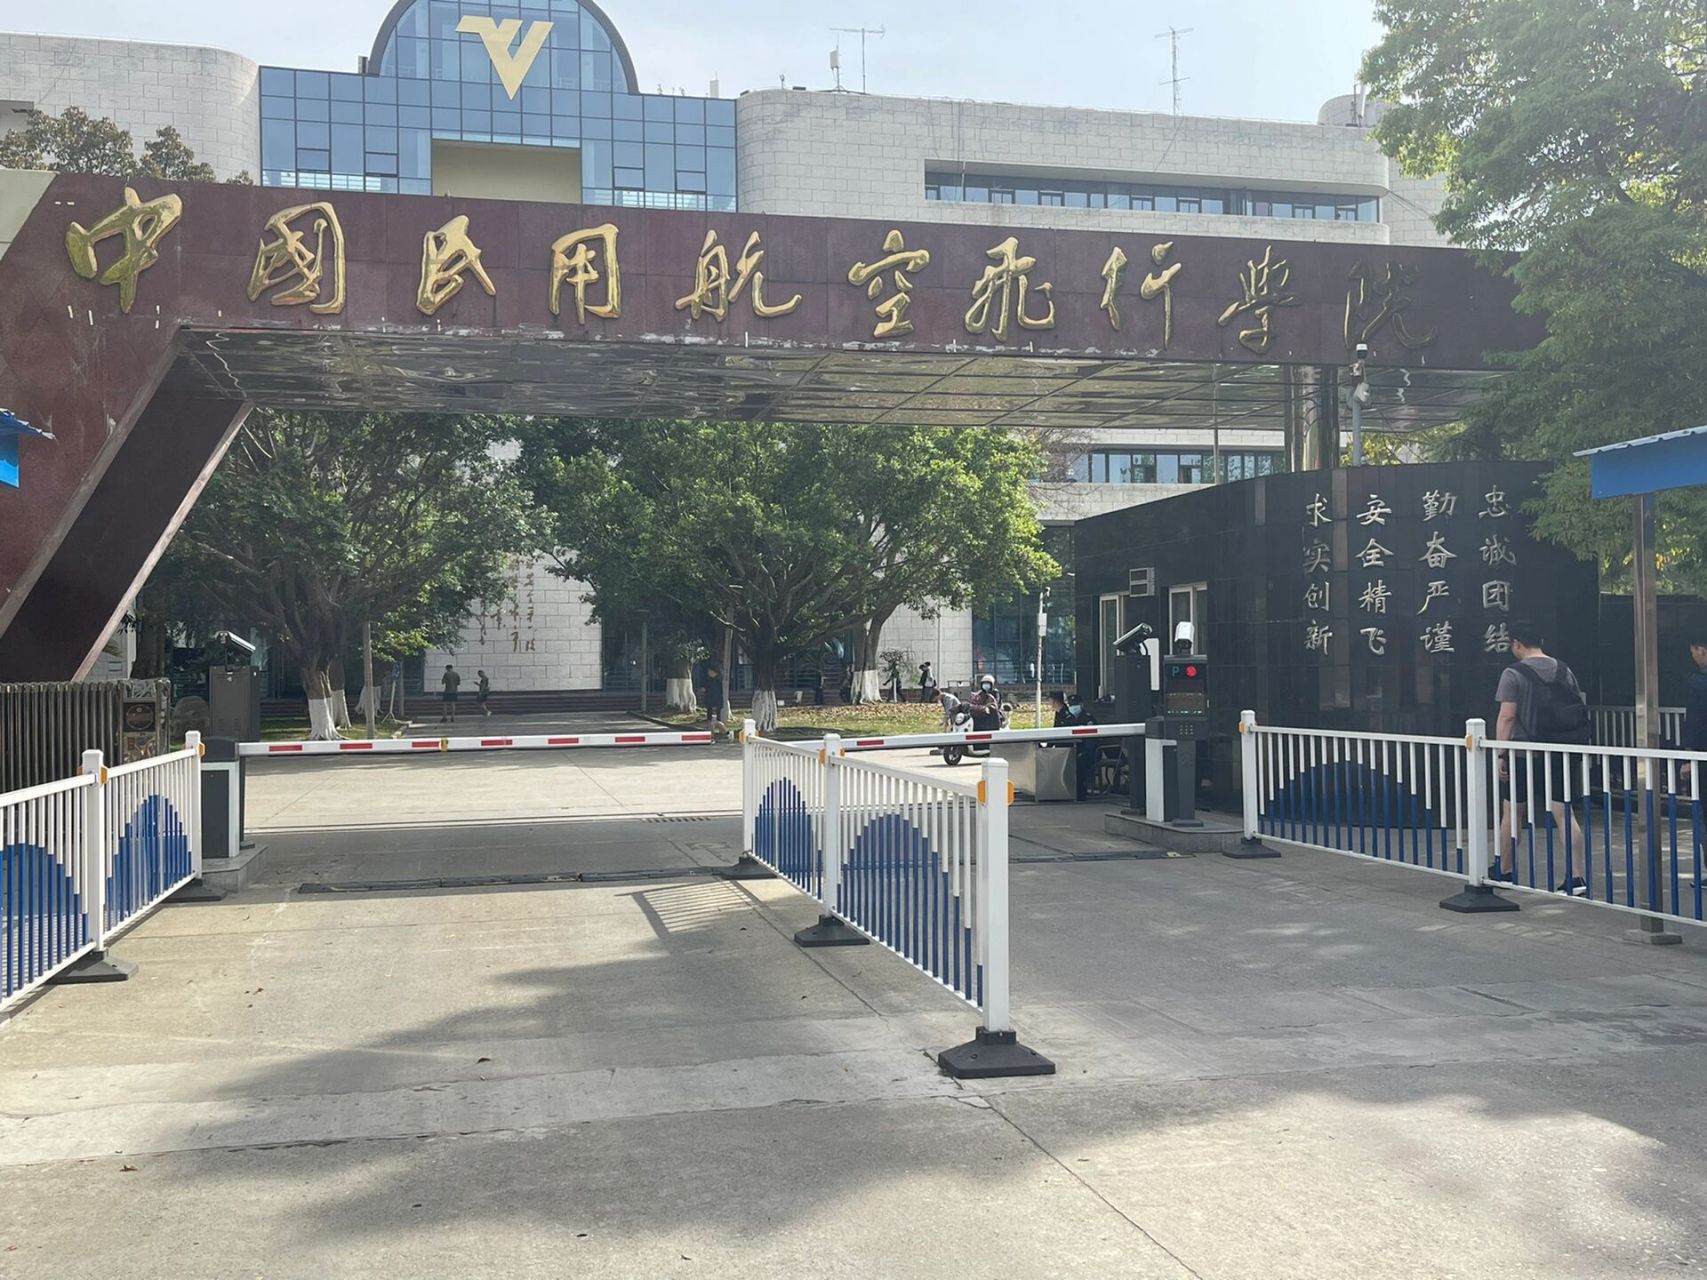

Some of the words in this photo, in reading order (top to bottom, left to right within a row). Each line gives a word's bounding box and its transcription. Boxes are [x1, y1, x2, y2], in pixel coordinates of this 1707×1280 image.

[1303, 494, 1333, 656] 求实创新
[1356, 494, 1394, 655] 安全精飞
[1416, 488, 1458, 654] 勤奋严谨
[1478, 484, 1517, 653] 忠诚团结
